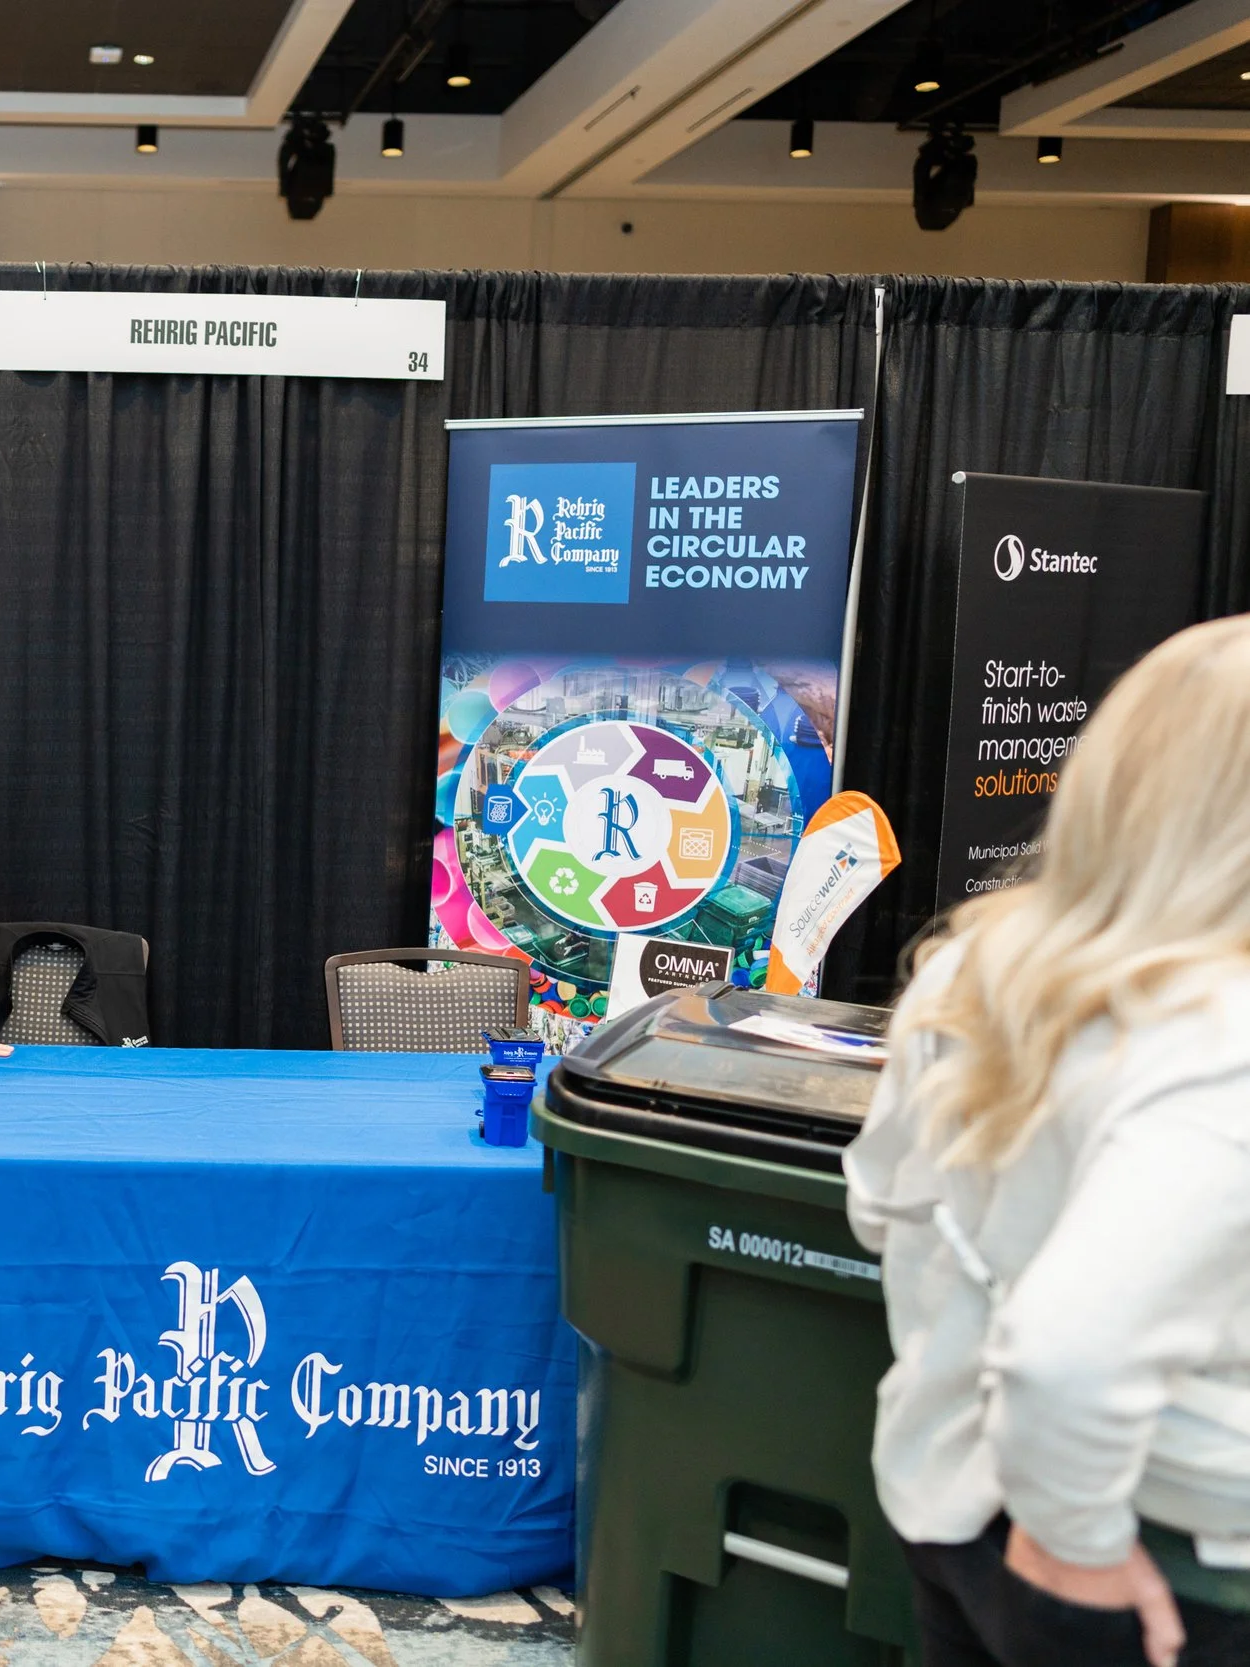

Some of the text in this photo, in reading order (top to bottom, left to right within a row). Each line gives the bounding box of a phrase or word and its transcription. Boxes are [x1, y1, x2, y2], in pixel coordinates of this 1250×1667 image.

[130, 318, 278, 348] REHRIG PACIFIC
[408, 351, 429, 373] 34
[650, 475, 780, 500] LEADERS
[552, 496, 606, 522] Rehrig
[648, 506, 743, 529] IN THE
[498, 494, 548, 568] R
[550, 520, 603, 544] Pacific
[550, 541, 619, 566] Company
[646, 534, 807, 559] CIRCULAR
[1029, 547, 1098, 574] Stantec
[645, 564, 810, 590] ECONOMY
[983, 659, 1066, 688] Start-to-
[981, 695, 1088, 725] finish waste
[974, 767, 1058, 798] solutions
[592, 787, 643, 862] R
[968, 842, 1019, 860] Municipal
[790, 864, 842, 938] Sourcewell
[654, 953, 716, 978] OMNIA
[658, 969, 710, 982] PARTNERS
[708, 1225, 804, 1268] SA 000012
[82, 1346, 272, 1432] Pacific
[291, 1350, 542, 1451] Company
[423, 1454, 542, 1478] SINCE 1913
